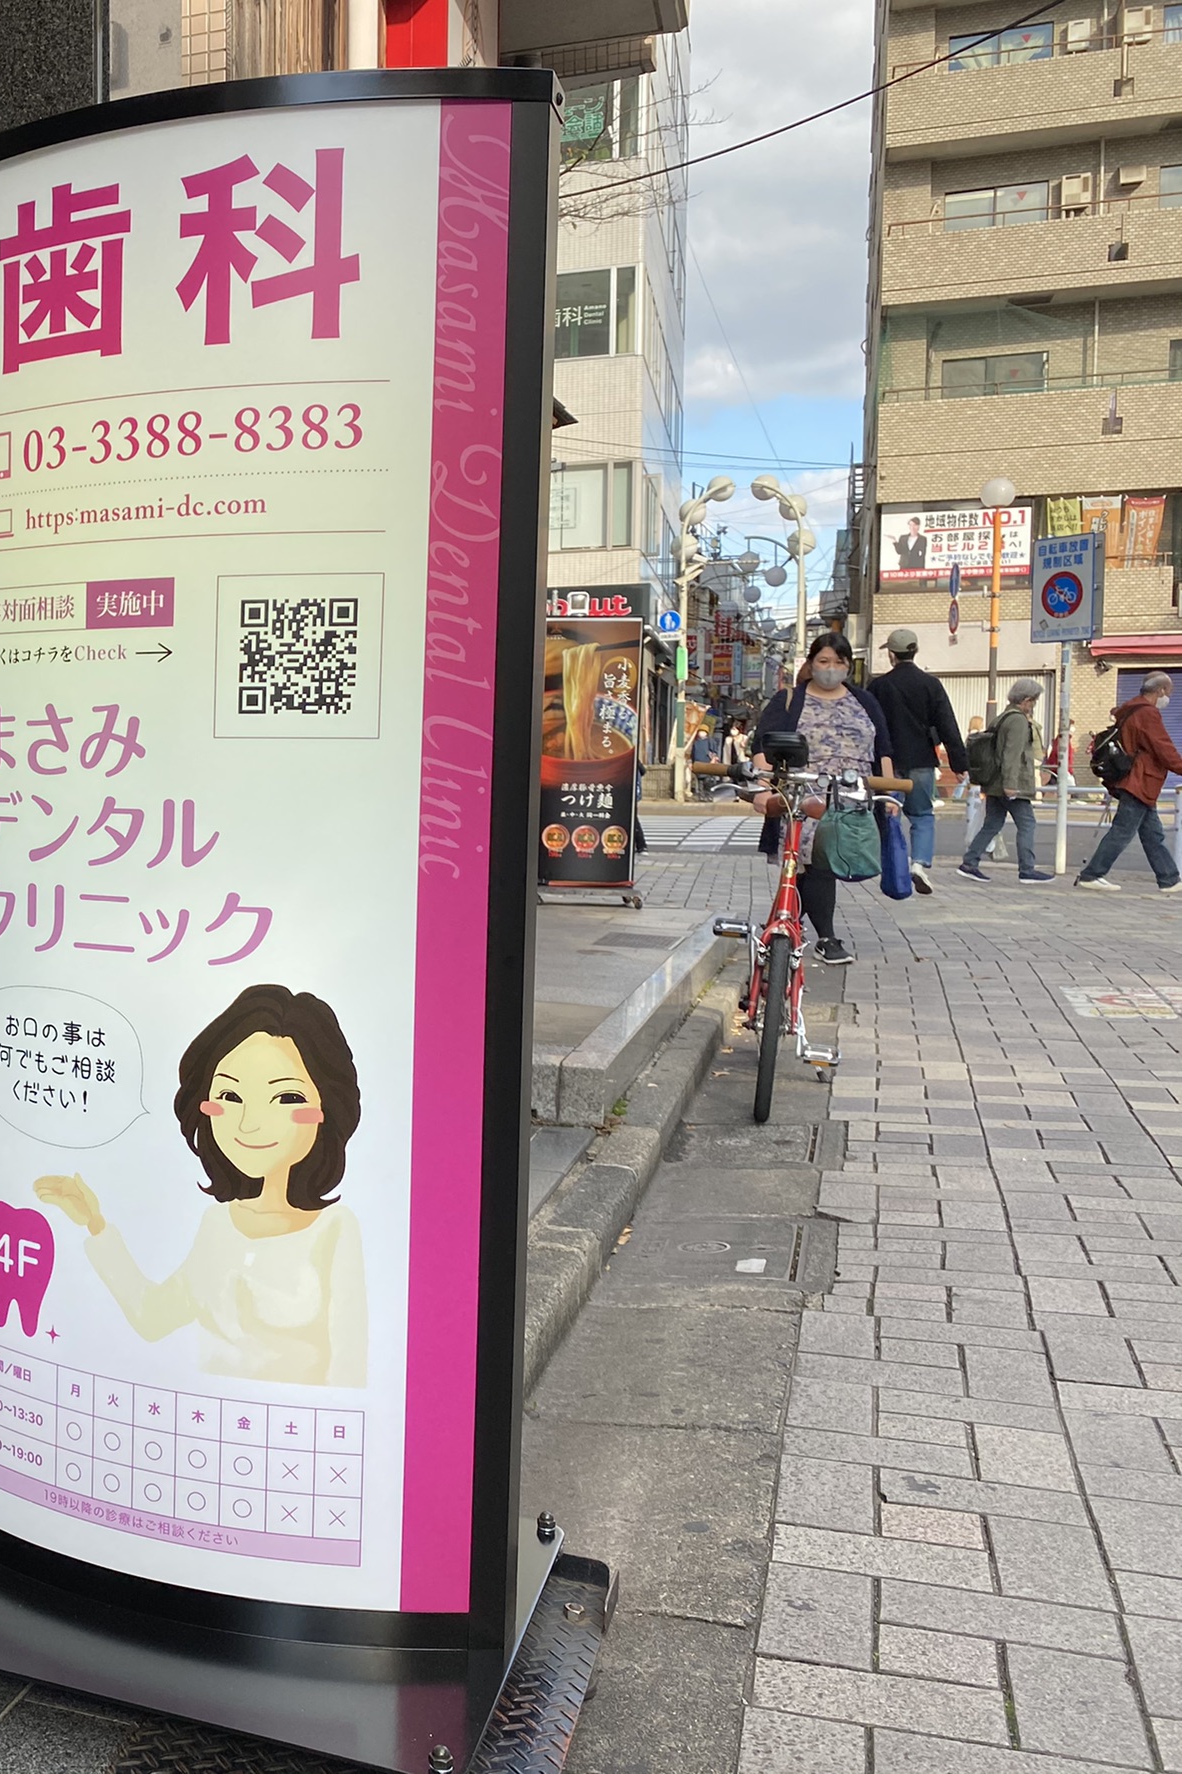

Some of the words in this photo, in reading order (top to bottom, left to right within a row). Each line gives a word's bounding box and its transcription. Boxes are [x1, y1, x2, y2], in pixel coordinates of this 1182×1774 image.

[432, 113, 511, 414] Masami
[22, 402, 365, 473] 03-3388-8383
[925, 513, 979, 528] 地域物件数
[982, 510, 1026, 526] NO.1
[931, 531, 1019, 543] お部屋探は
[931, 540, 1022, 553] 当ビル2へ!
[1038, 538, 1089, 558] 自転車放置
[426, 443, 504, 691] Dental
[1042, 553, 1084, 569] 規制区域
[95, 589, 165, 619] 実施中
[417, 714, 493, 881] Clinic
[560, 792, 614, 810] つけ麺
[4, 1014, 106, 1048] お口の事は
[12, 1079, 88, 1113] ください!
[70, 1383, 81, 1398] 月
[107, 1392, 119, 1407] 火
[147, 1402, 161, 1415] 水
[191, 1409, 205, 1423] 木
[237, 1416, 251, 1430] 金
[284, 1421, 298, 1435] 土
[333, 1425, 345, 1439] 日
[43, 1488, 239, 1546] 19時以降の診療はご相談ください
